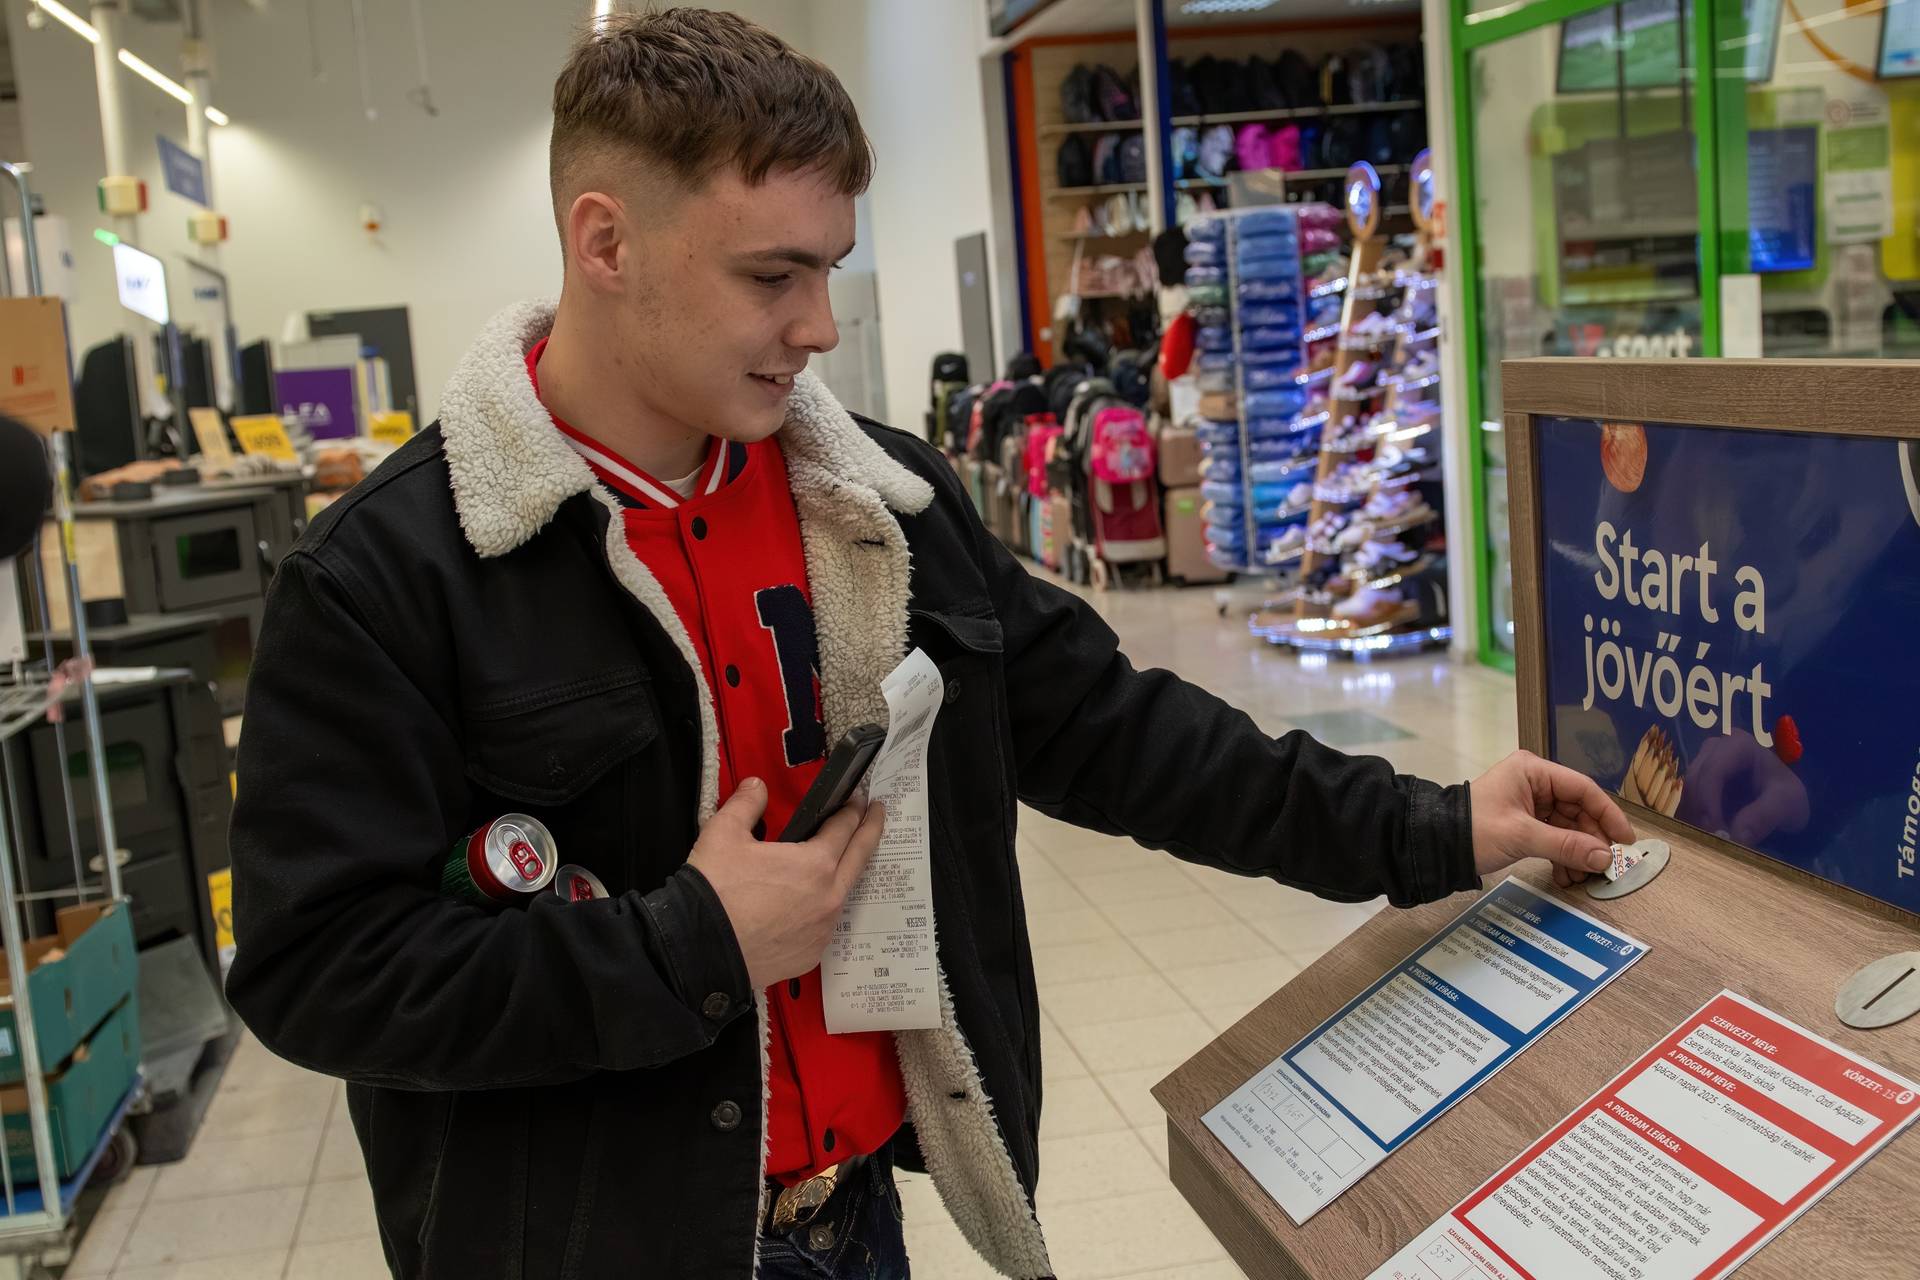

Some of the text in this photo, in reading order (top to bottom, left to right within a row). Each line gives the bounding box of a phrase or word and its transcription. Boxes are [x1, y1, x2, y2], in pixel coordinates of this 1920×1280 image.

[1594, 521, 1764, 634] Start a
[1583, 614, 1774, 748] jövőért
[1585, 932, 1611, 948] KÖRZET:
[1412, 969, 1438, 986] PROGRAM
[1435, 984, 1459, 1002] LEÍRÁSA:
[1526, 983, 1553, 1001] támogató
[1444, 1040, 1456, 1050] még
[1684, 1037, 1775, 1091] Csere János Általános Iskola
[1710, 1016, 1778, 1055] SZERVEZET NEVE:
[1674, 1054, 1714, 1078] PROGRAM
[1712, 1075, 1736, 1092] NEVE:
[1694, 1029, 1744, 1058] Kazincbarcikai
[1740, 1054, 1783, 1079] Tankerületi
[1780, 1076, 1813, 1096] Központ
[1834, 1105, 1868, 1126] Apáczai
[1843, 1069, 1882, 1093] KÖRZET:
[1882, 1090, 1896, 1100] 15
[1612, 1105, 1649, 1131] PROGRAM
[1647, 1128, 1681, 1153] LEÍRÁSA:
[1652, 1063, 1816, 1163] Apáczai napok 2025 Fenntarthatósági témahét
[1567, 1131, 1609, 1163] iskoláskorban
[1608, 1161, 1651, 1191] megismerjék
[1654, 1192, 1710, 1235] fenntarthatóság
[1578, 1123, 1710, 1216] legfogékonyabbak. Ezért fontos, hogy már
[1595, 1119, 1649, 1156] szemléletváltásra
[1652, 1159, 1694, 1186] gyermekek
[1513, 1175, 1543, 1200] kiemelten
[1541, 1197, 1565, 1216] kezelik
[1588, 1234, 1630, 1268] hozzájárulva
[1628, 1267, 1643, 1280] egy
[1535, 1159, 1579, 1192] odafigyeléssel
[1576, 1188, 1587, 1197] ők
[1584, 1194, 1592, 1202] is
[1590, 1201, 1611, 1216] sokat
[1608, 1213, 1640, 1238] tehetnek
[1644, 1240, 1662, 1254] Föld
[1546, 1150, 1578, 1174] személyes
[1630, 1211, 1649, 1225] Mert
[1646, 1224, 1660, 1236] egy
[1660, 1232, 1672, 1243] kis
[1624, 1189, 1635, 1198] és
[1633, 1195, 1668, 1223] tudatában
[1667, 1220, 1702, 1246] legyenek
[1530, 1206, 1540, 1215] és
[1538, 1213, 1591, 1257] környezettudatos
[1558, 1192, 1568, 1202] Az
[1567, 1199, 1594, 1220] Apáczai
[1591, 1219, 1614, 1236] napok
[1609, 1234, 1650, 1264] programjai
